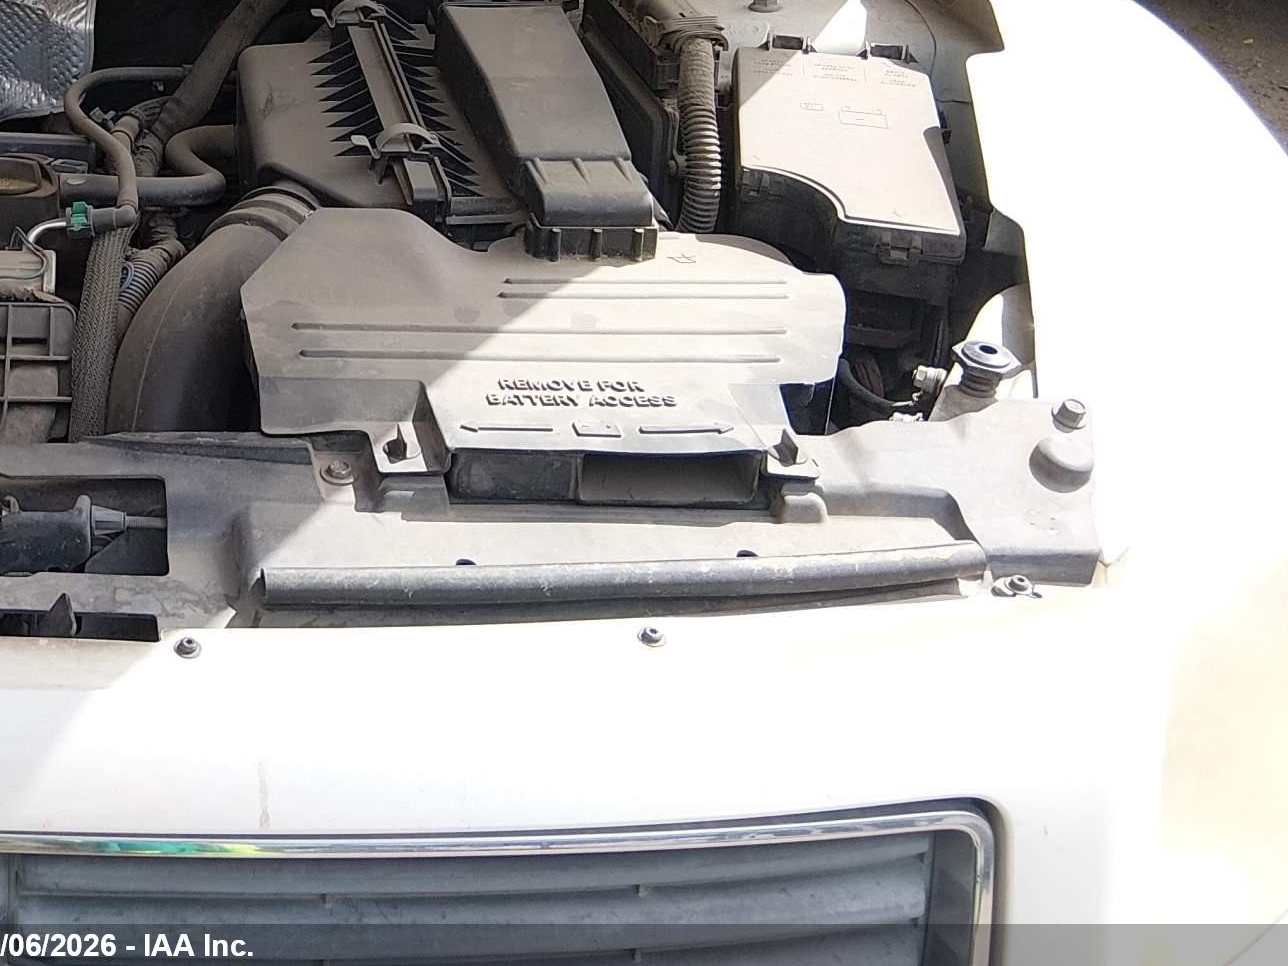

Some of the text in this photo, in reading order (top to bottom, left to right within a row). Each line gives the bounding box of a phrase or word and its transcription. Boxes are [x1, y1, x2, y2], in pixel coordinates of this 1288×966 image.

[498, 378, 645, 392] REMOVE FOR
[486, 393, 677, 407] BATTERY ACCESS
